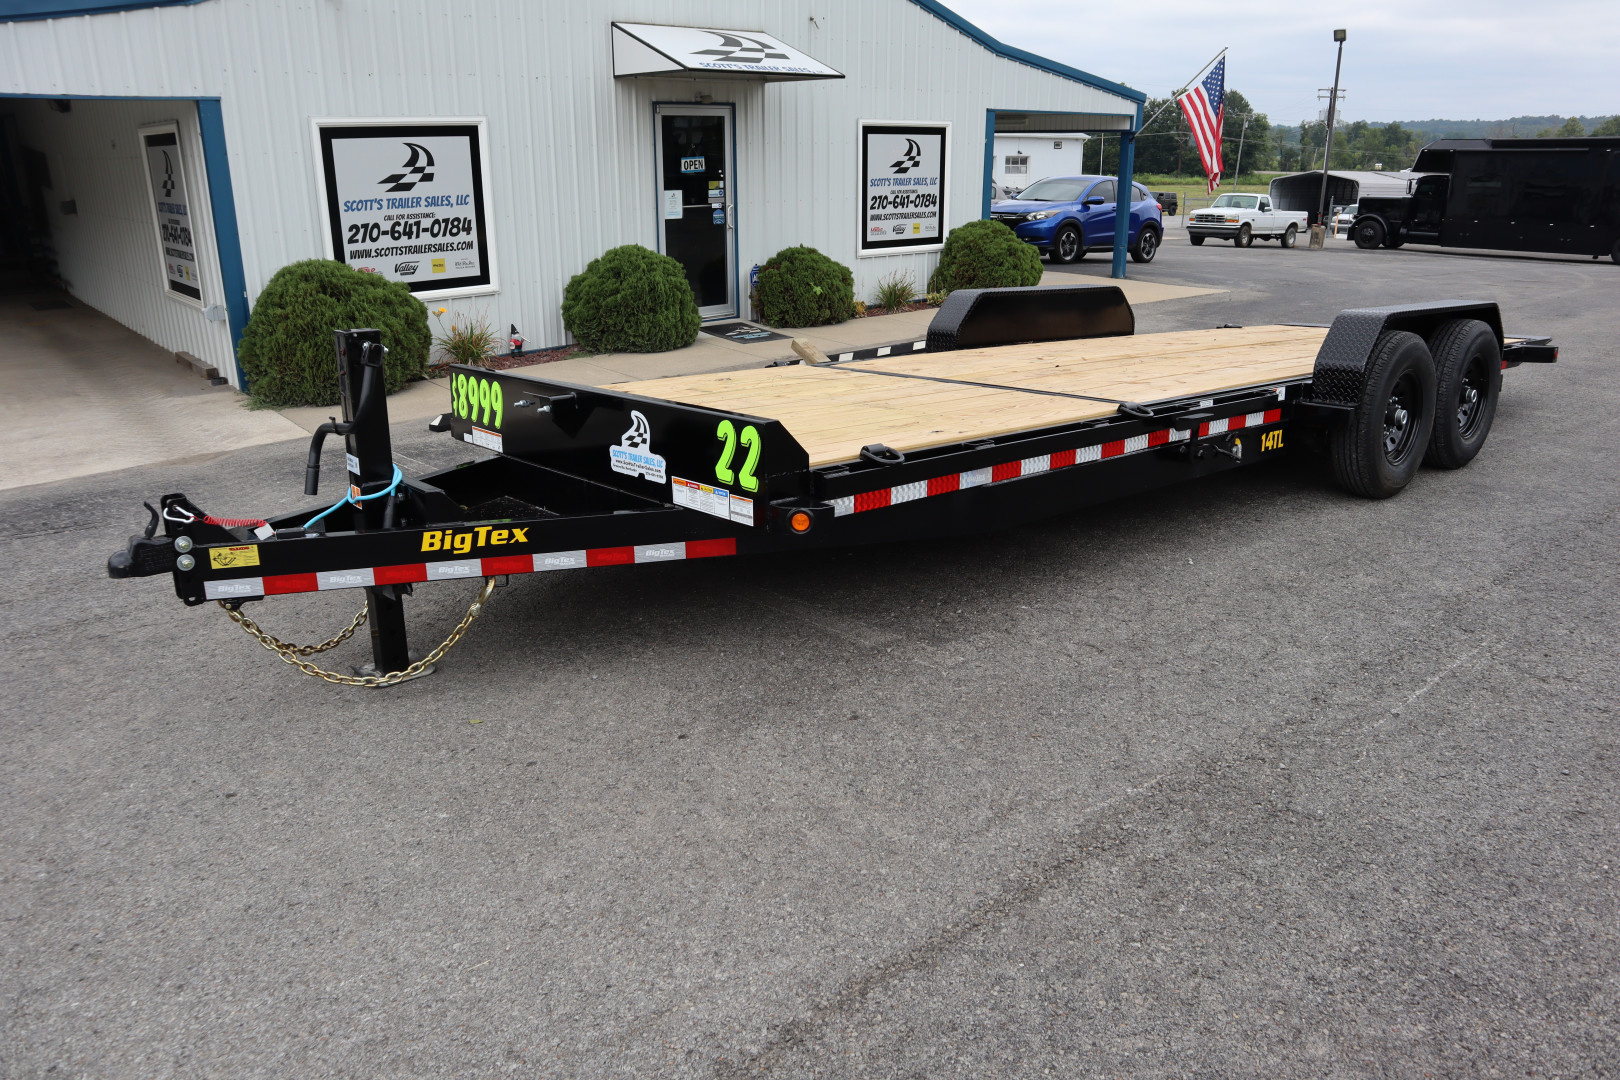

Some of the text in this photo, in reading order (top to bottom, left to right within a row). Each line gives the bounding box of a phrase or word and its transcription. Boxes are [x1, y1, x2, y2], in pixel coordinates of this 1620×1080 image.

[684, 160, 703, 170] OPEN
[870, 178, 891, 187] SCOTT'S
[343, 194, 470, 213] SCOTT'S TRAILER SALES, LLC
[870, 193, 937, 210] 270-641-0784
[395, 213, 406, 221] FOR
[347, 217, 472, 245] 270-641-0784
[349, 240, 474, 260] WWW.SCOTTSTRAILERSALES.COM
[395, 262, 419, 274] Valley
[1261, 429, 1284, 452] 14TL
[715, 419, 761, 493] 22
[421, 526, 529, 554] BigTex
[645, 548, 675, 557] BigTex
[544, 556, 576, 565] BigTex
[438, 565, 470, 574] BigTex
[329, 574, 362, 584] BigTex
[218, 584, 252, 593] BigTex
